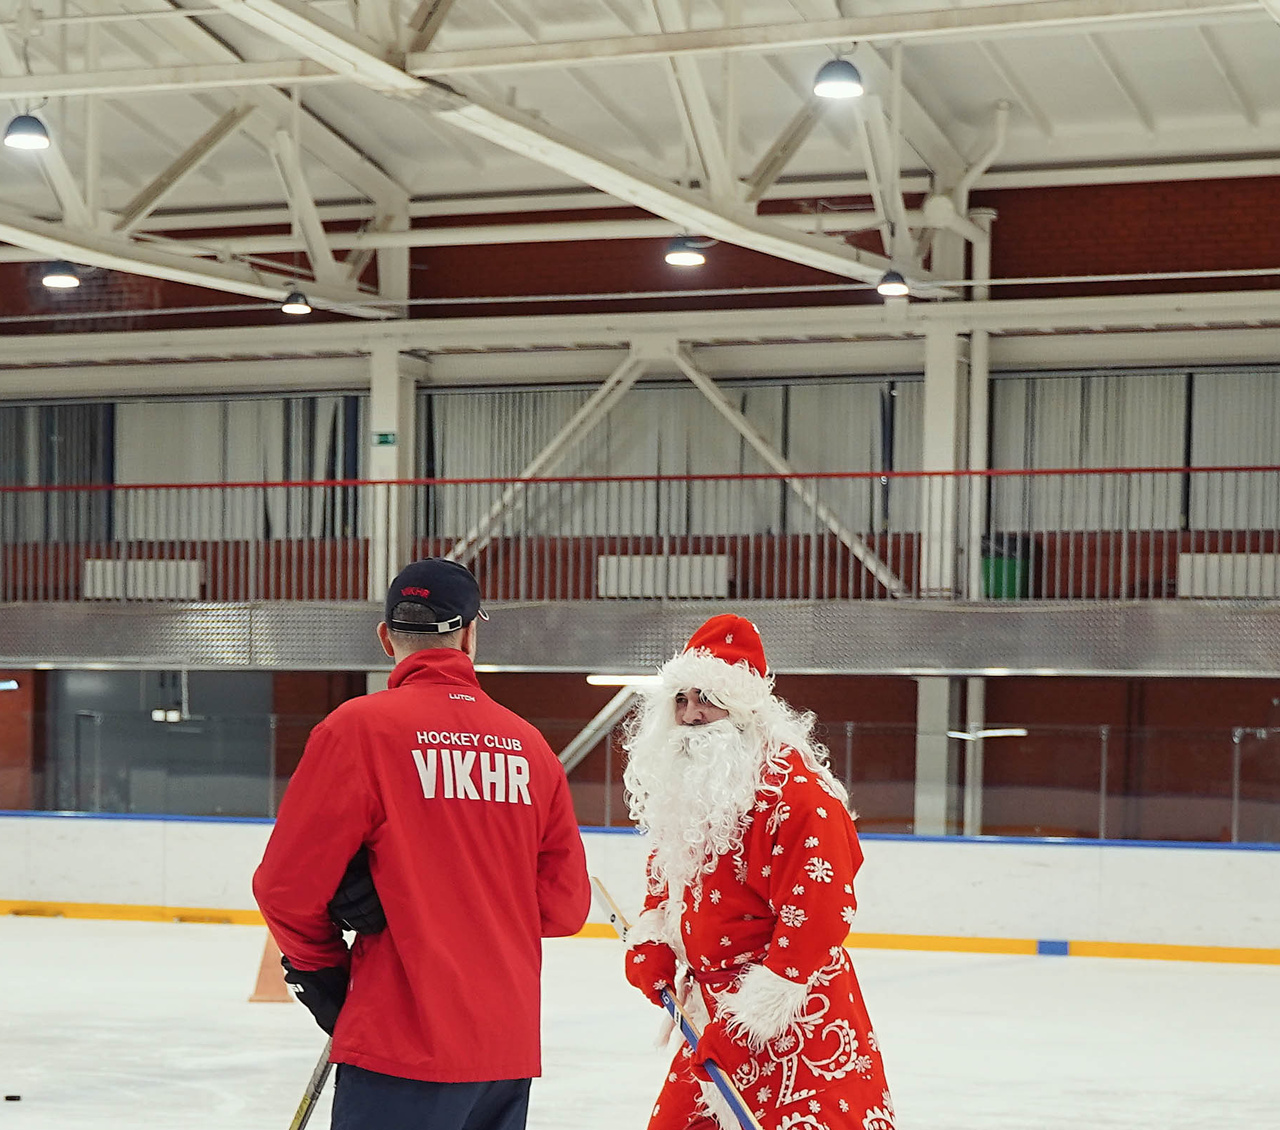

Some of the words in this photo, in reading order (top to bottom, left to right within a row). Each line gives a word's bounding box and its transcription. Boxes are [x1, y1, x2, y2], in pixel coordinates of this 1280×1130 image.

[401, 586, 431, 599] VIKHR
[449, 693, 476, 702] LUTCH
[417, 732, 480, 747] HOCKEY
[484, 735, 522, 751] CLUB
[411, 749, 532, 805] VIKHR
